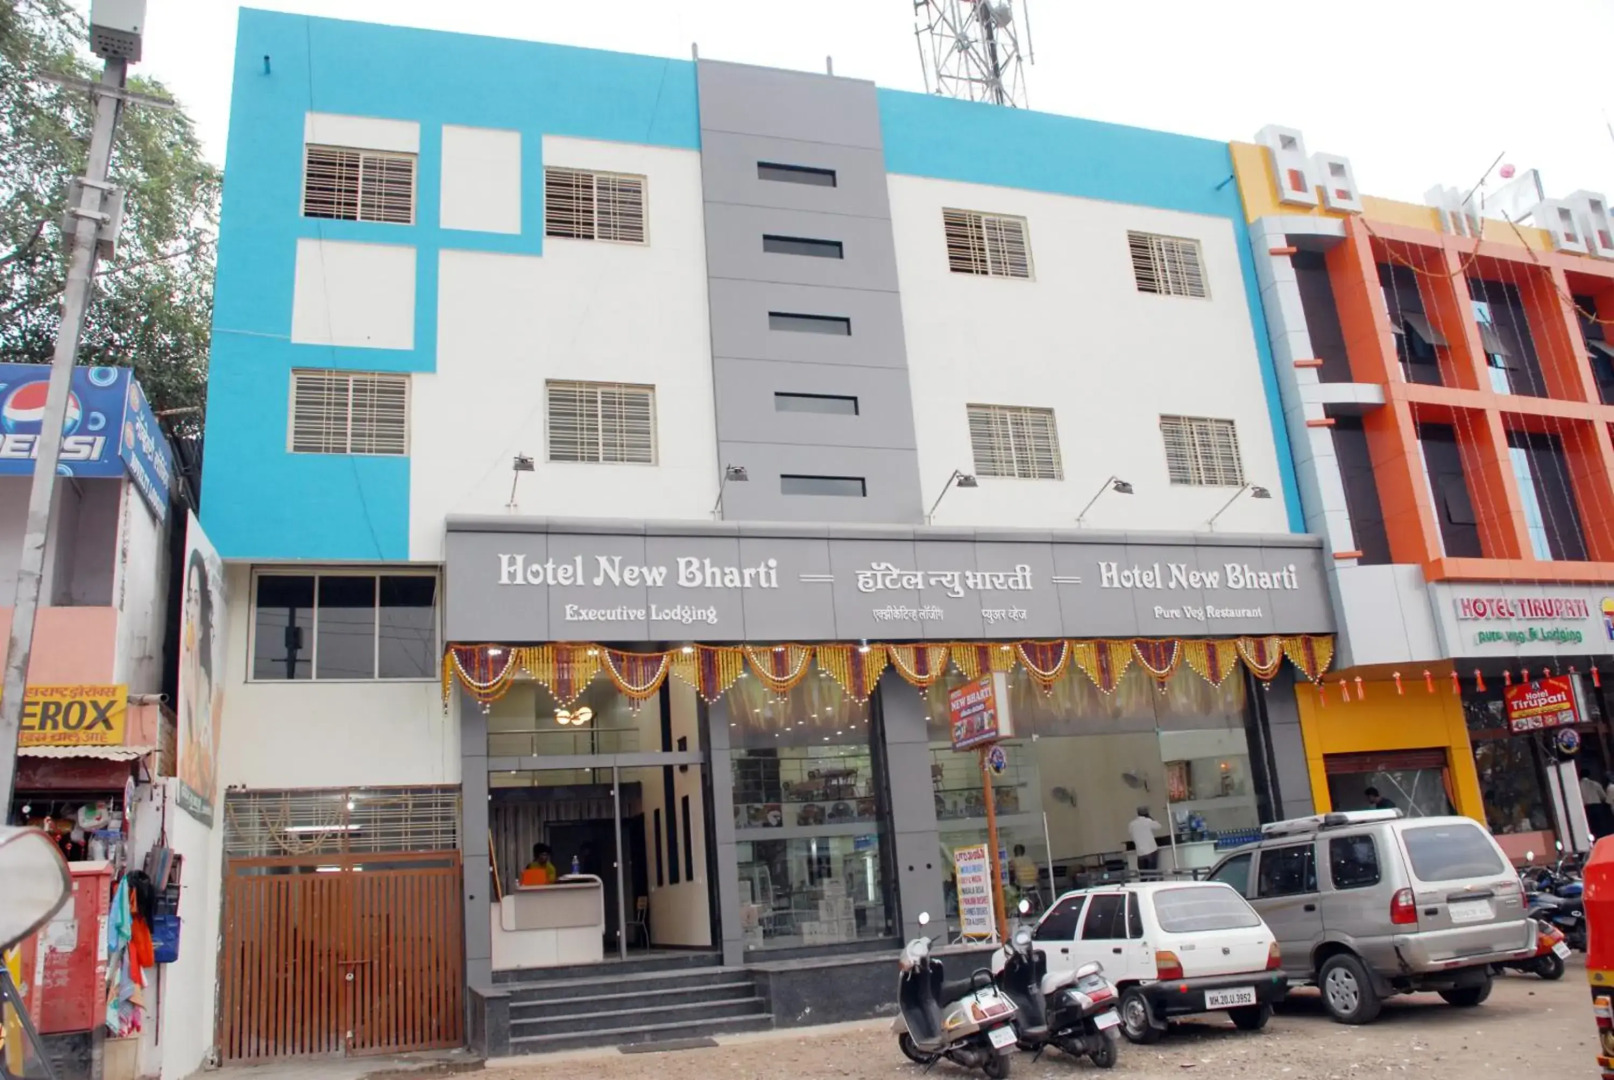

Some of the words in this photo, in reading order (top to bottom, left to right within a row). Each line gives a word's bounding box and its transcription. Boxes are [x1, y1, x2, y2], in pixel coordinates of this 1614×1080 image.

[0, 434, 106, 462] ESI
[498, 553, 584, 587] Hotel
[594, 556, 666, 588] New
[676, 557, 779, 589] Bharti
[855, 562, 925, 593] हॉटेल
[927, 570, 965, 598] न्यु
[965, 564, 1033, 591] भारती
[1099, 561, 1162, 590] Hotel
[1168, 563, 1220, 591] New
[1224, 564, 1299, 591] Bharti
[565, 603, 646, 622] Executive
[650, 604, 718, 625] Lodging
[1153, 604, 1182, 620] Pure
[1182, 604, 1205, 622] Veg
[1205, 604, 1263, 620] Restaurant
[1460, 598, 1515, 617] HOTEL
[1517, 598, 1590, 618] TIRUPATI
[1541, 627, 1583, 644] Lodging
[1511, 691, 1567, 709] Tirupati
[1525, 689, 1549, 700] Hotel
[19, 699, 118, 731] EROX
